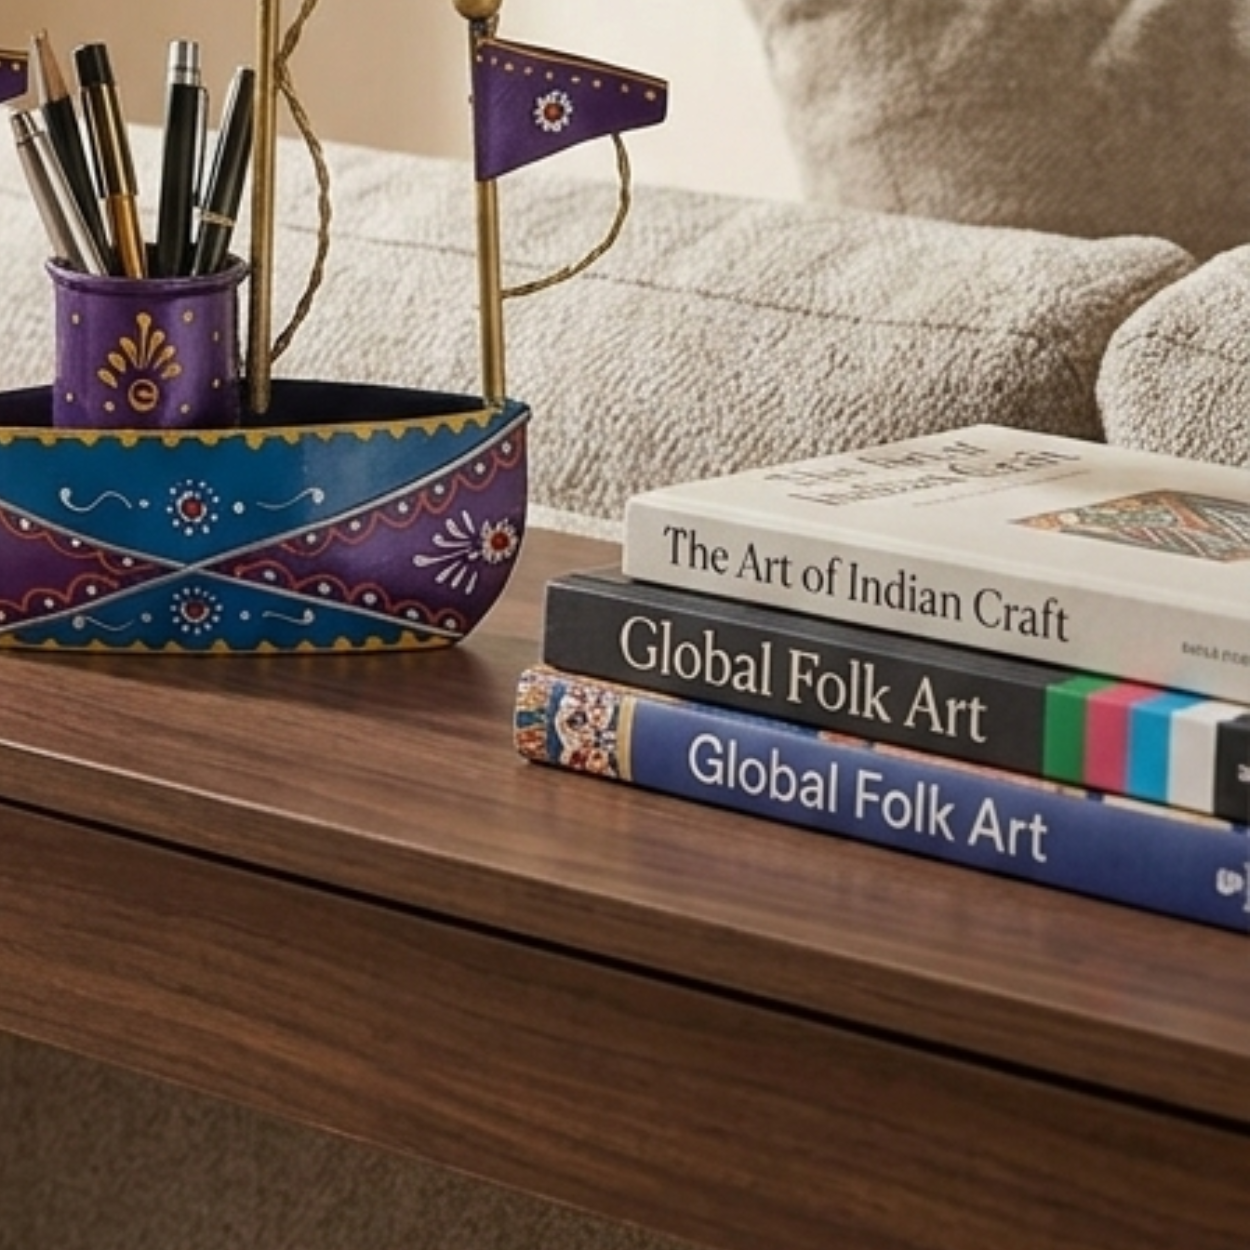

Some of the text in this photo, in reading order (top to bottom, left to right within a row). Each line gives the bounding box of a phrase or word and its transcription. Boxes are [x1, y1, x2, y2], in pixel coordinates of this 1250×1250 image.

[663, 525, 1071, 643] The Art of Indian Craft
[620, 615, 988, 744] Global Folk Art
[688, 733, 1049, 863] Global Folk Art
